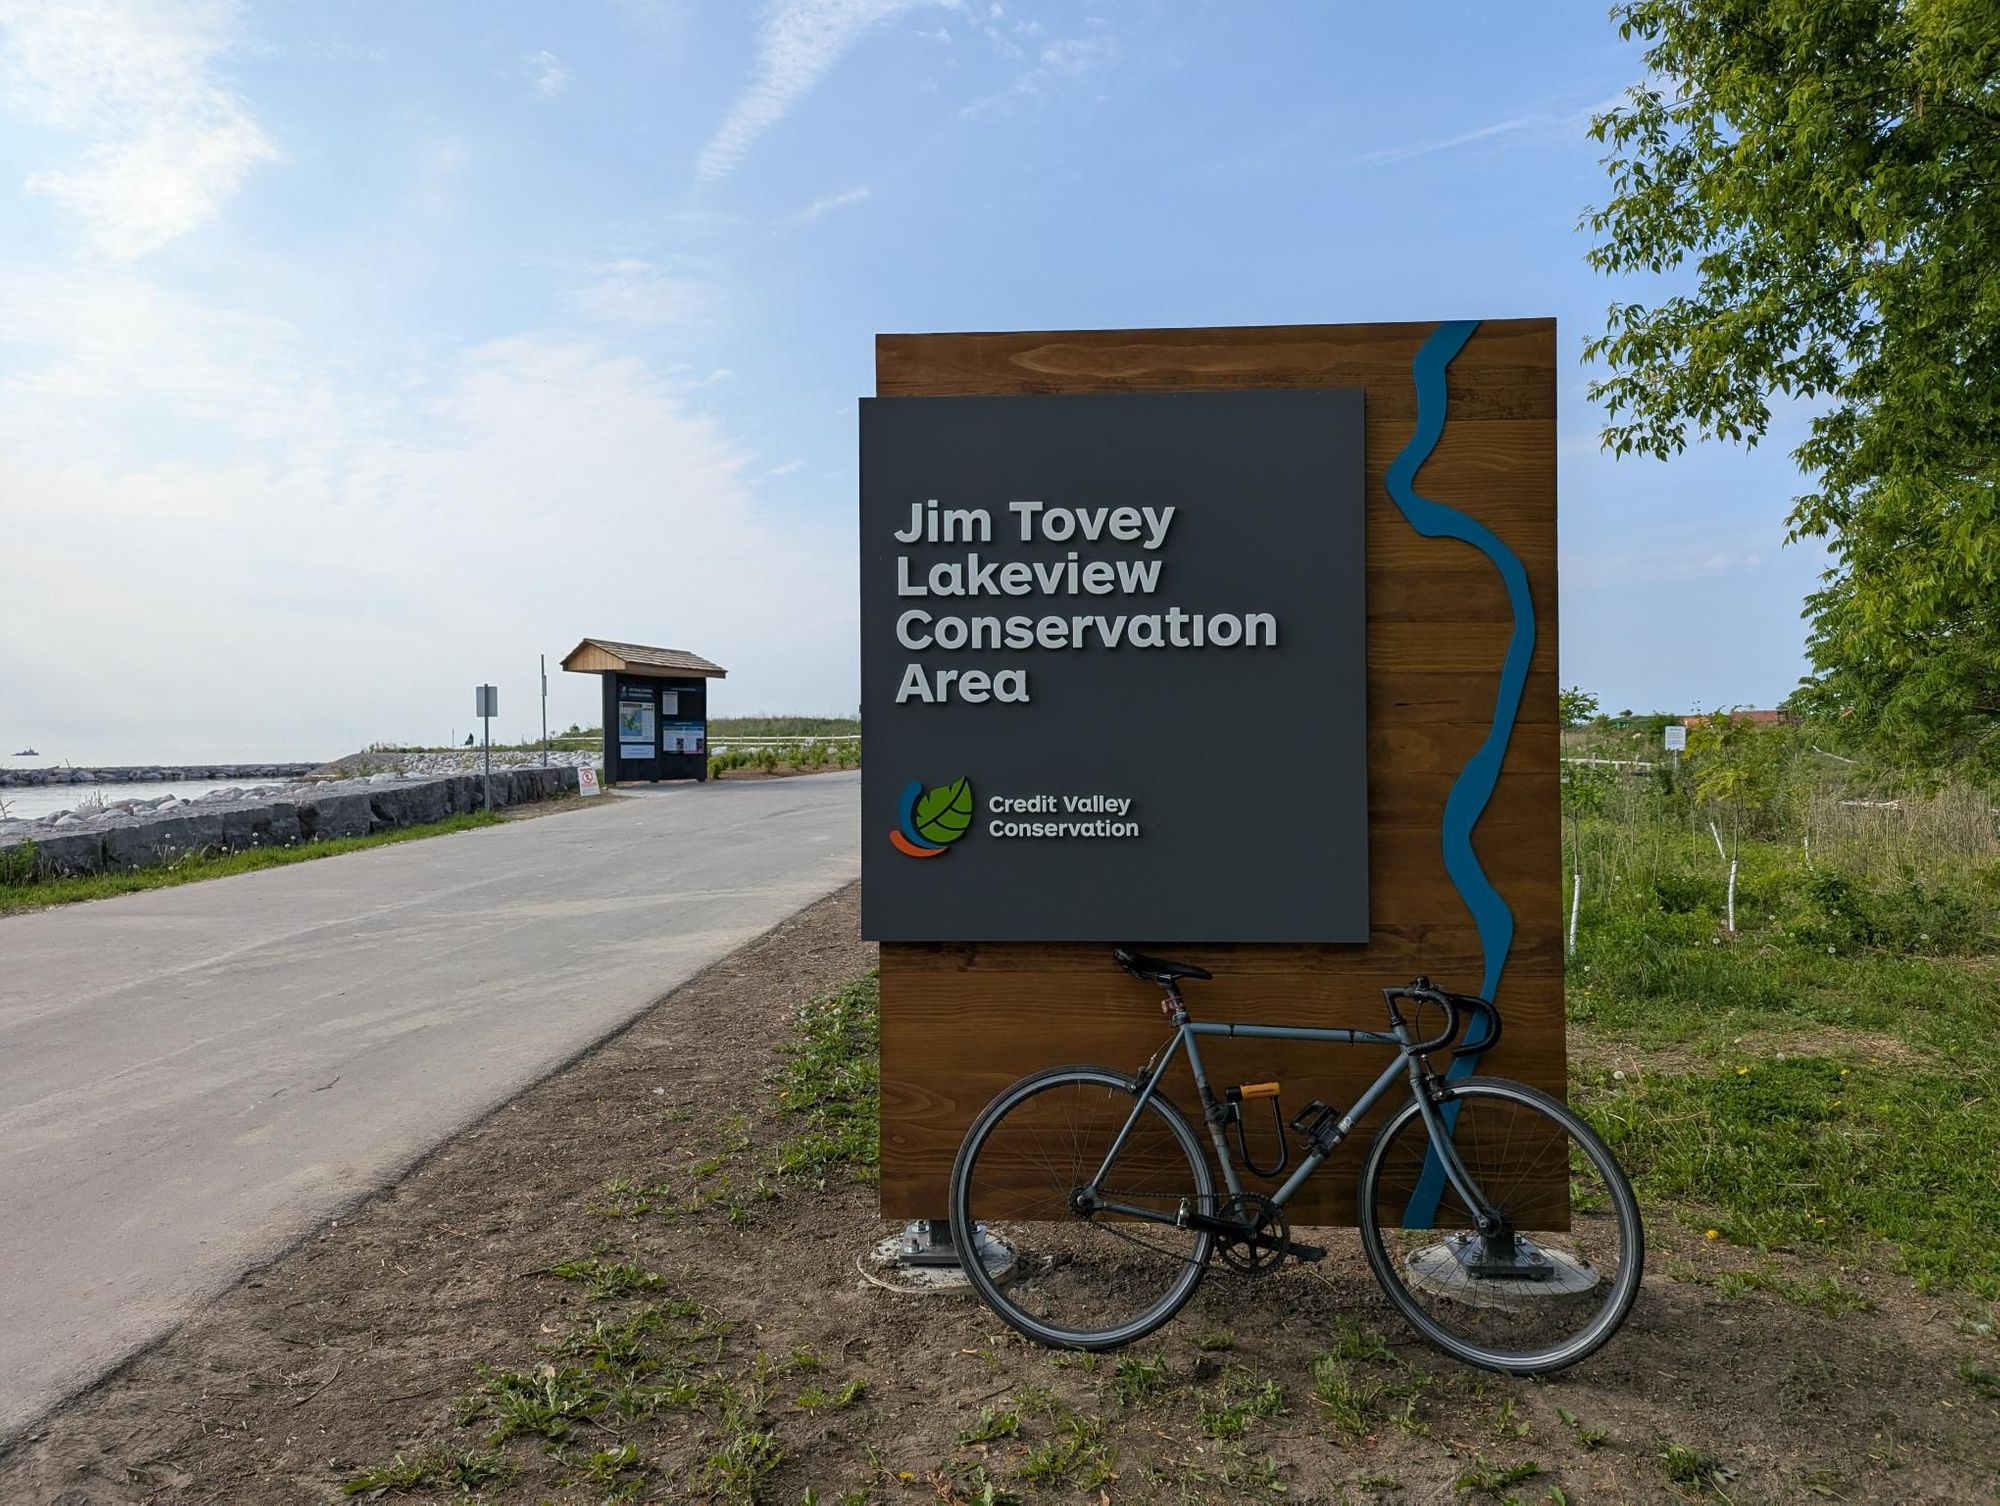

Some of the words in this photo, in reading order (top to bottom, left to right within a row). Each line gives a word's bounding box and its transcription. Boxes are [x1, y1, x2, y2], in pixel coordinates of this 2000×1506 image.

[894, 499, 991, 543] Jim
[1009, 501, 1176, 550] Tovey
[897, 552, 1162, 596] Lakeview
[895, 663, 1030, 703] Area
[989, 795, 1057, 813] Credit
[1062, 795, 1131, 816] Valley
[989, 819, 1140, 838] Conservation
